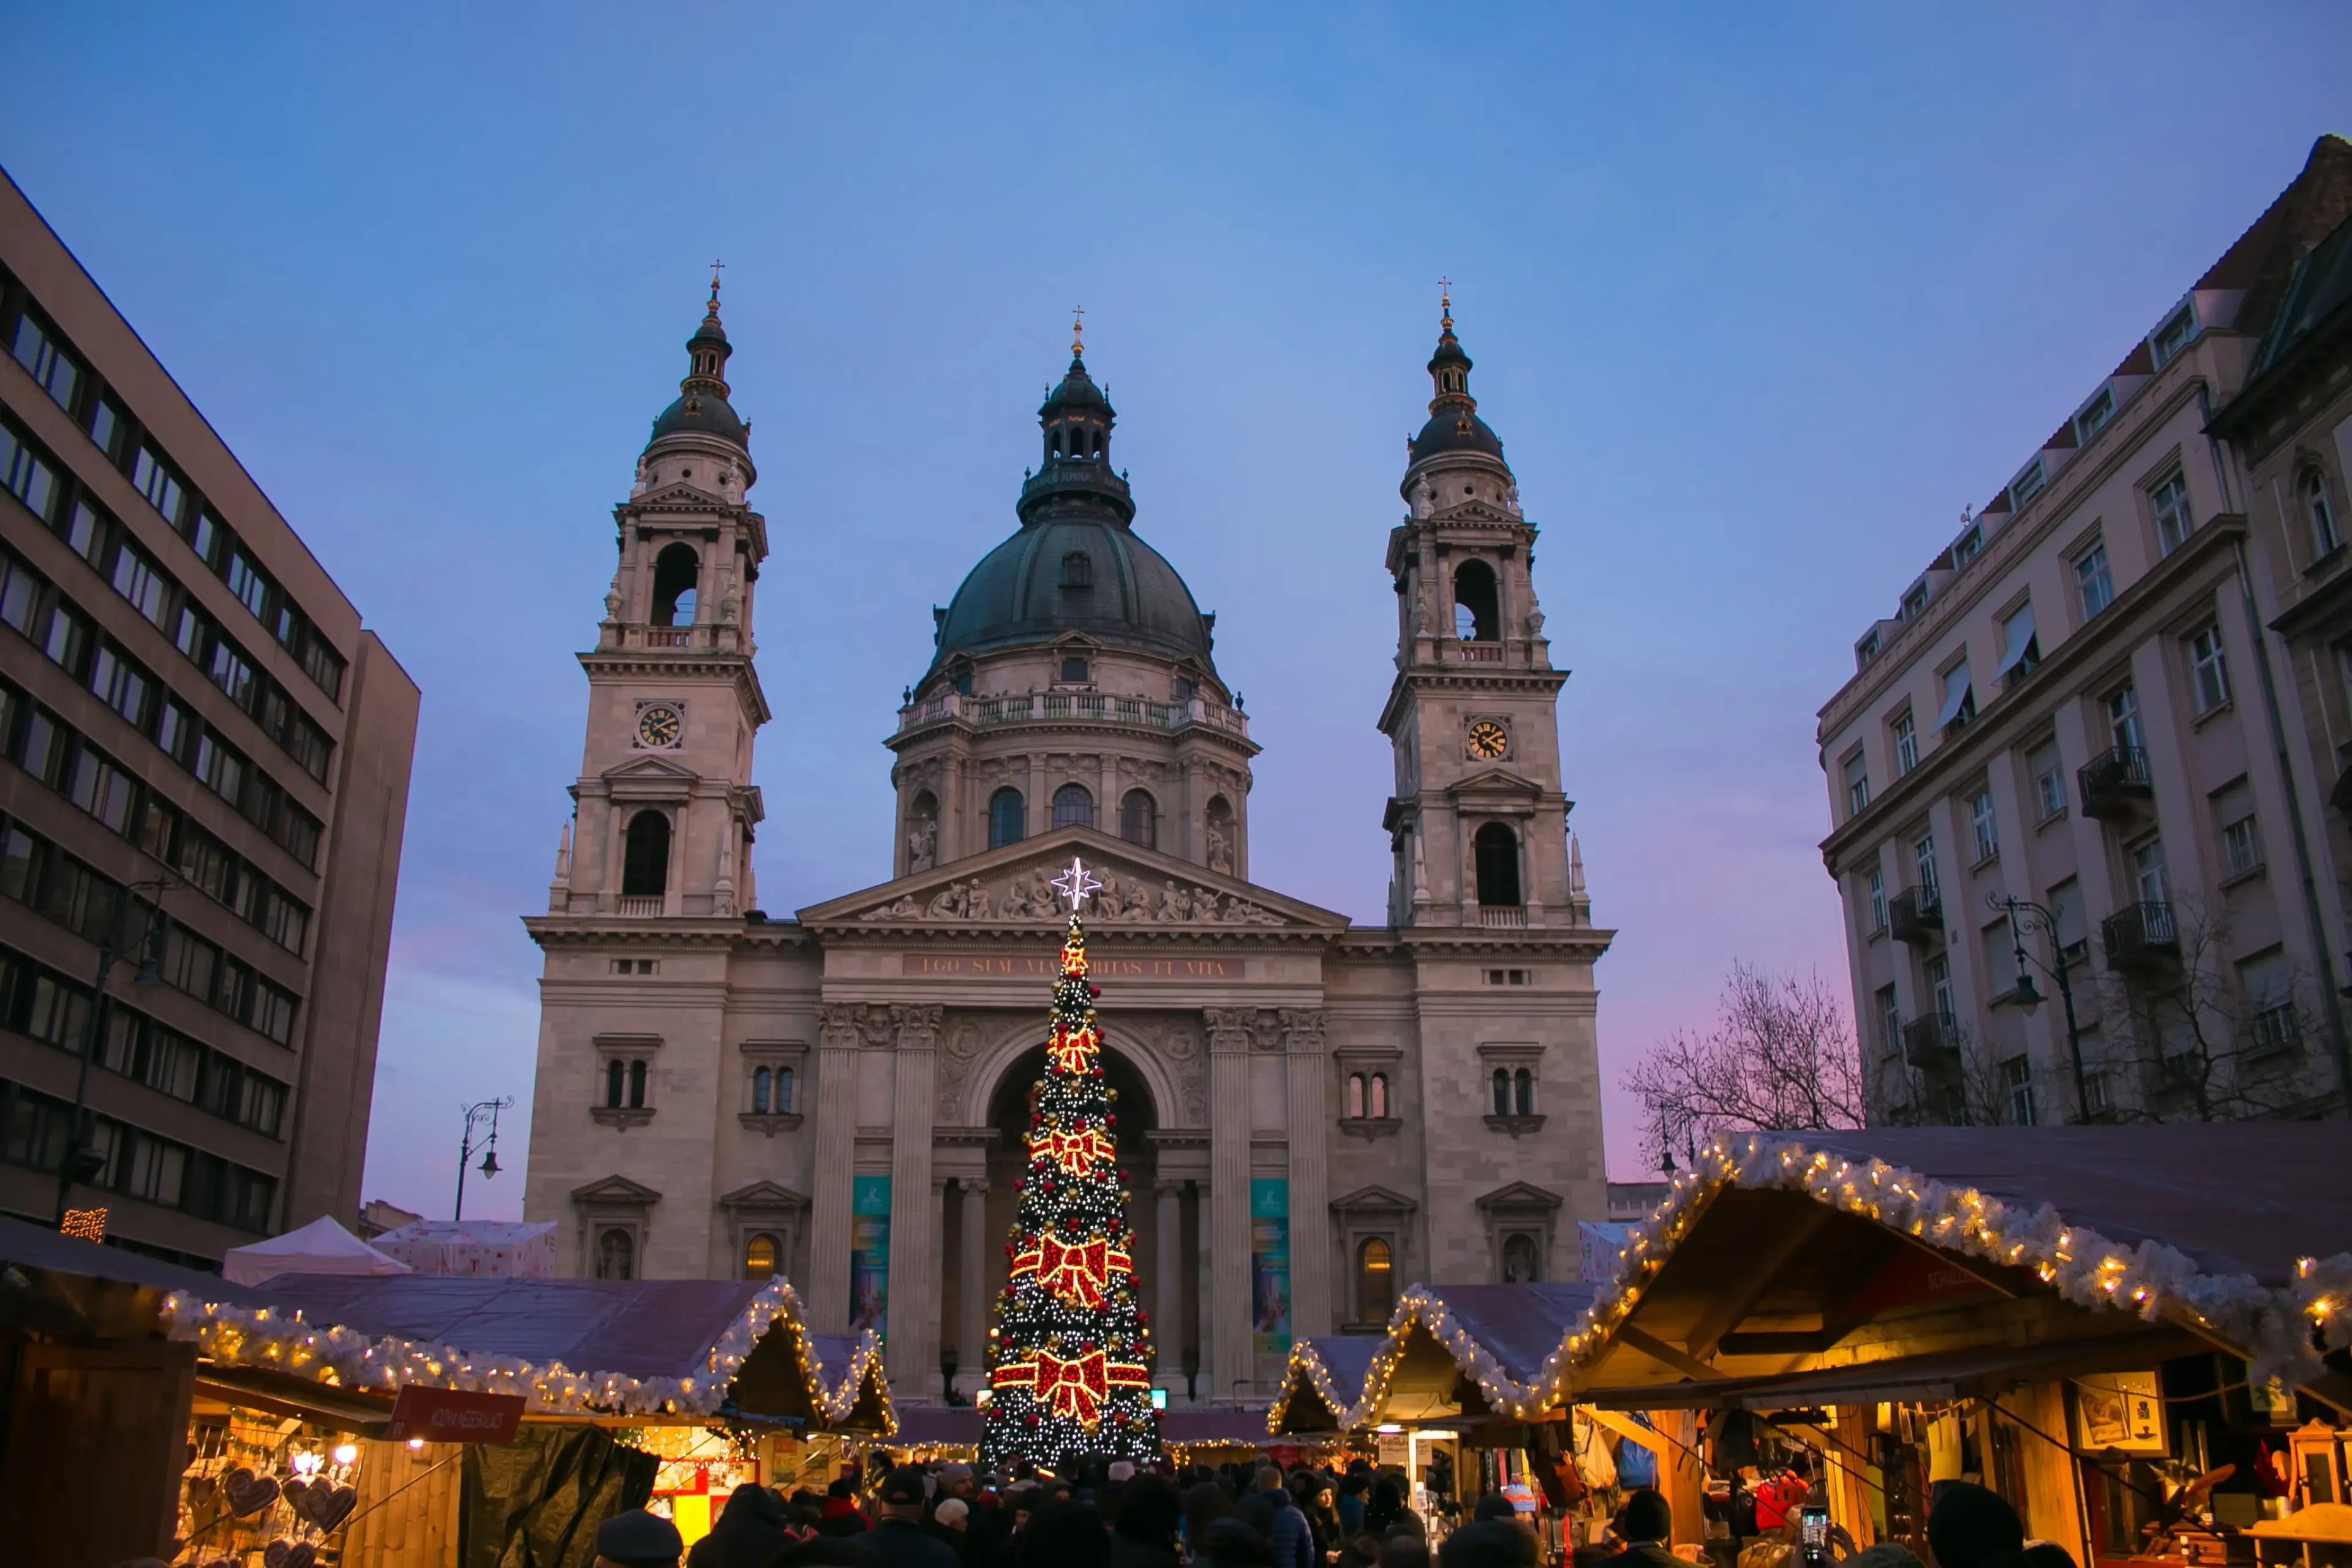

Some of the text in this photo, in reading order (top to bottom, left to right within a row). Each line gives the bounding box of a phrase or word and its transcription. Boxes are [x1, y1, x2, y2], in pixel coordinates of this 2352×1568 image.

[973, 959, 1011, 973] SUM
[1093, 961, 1142, 974] RITAS
[1187, 961, 1224, 976] VITA
